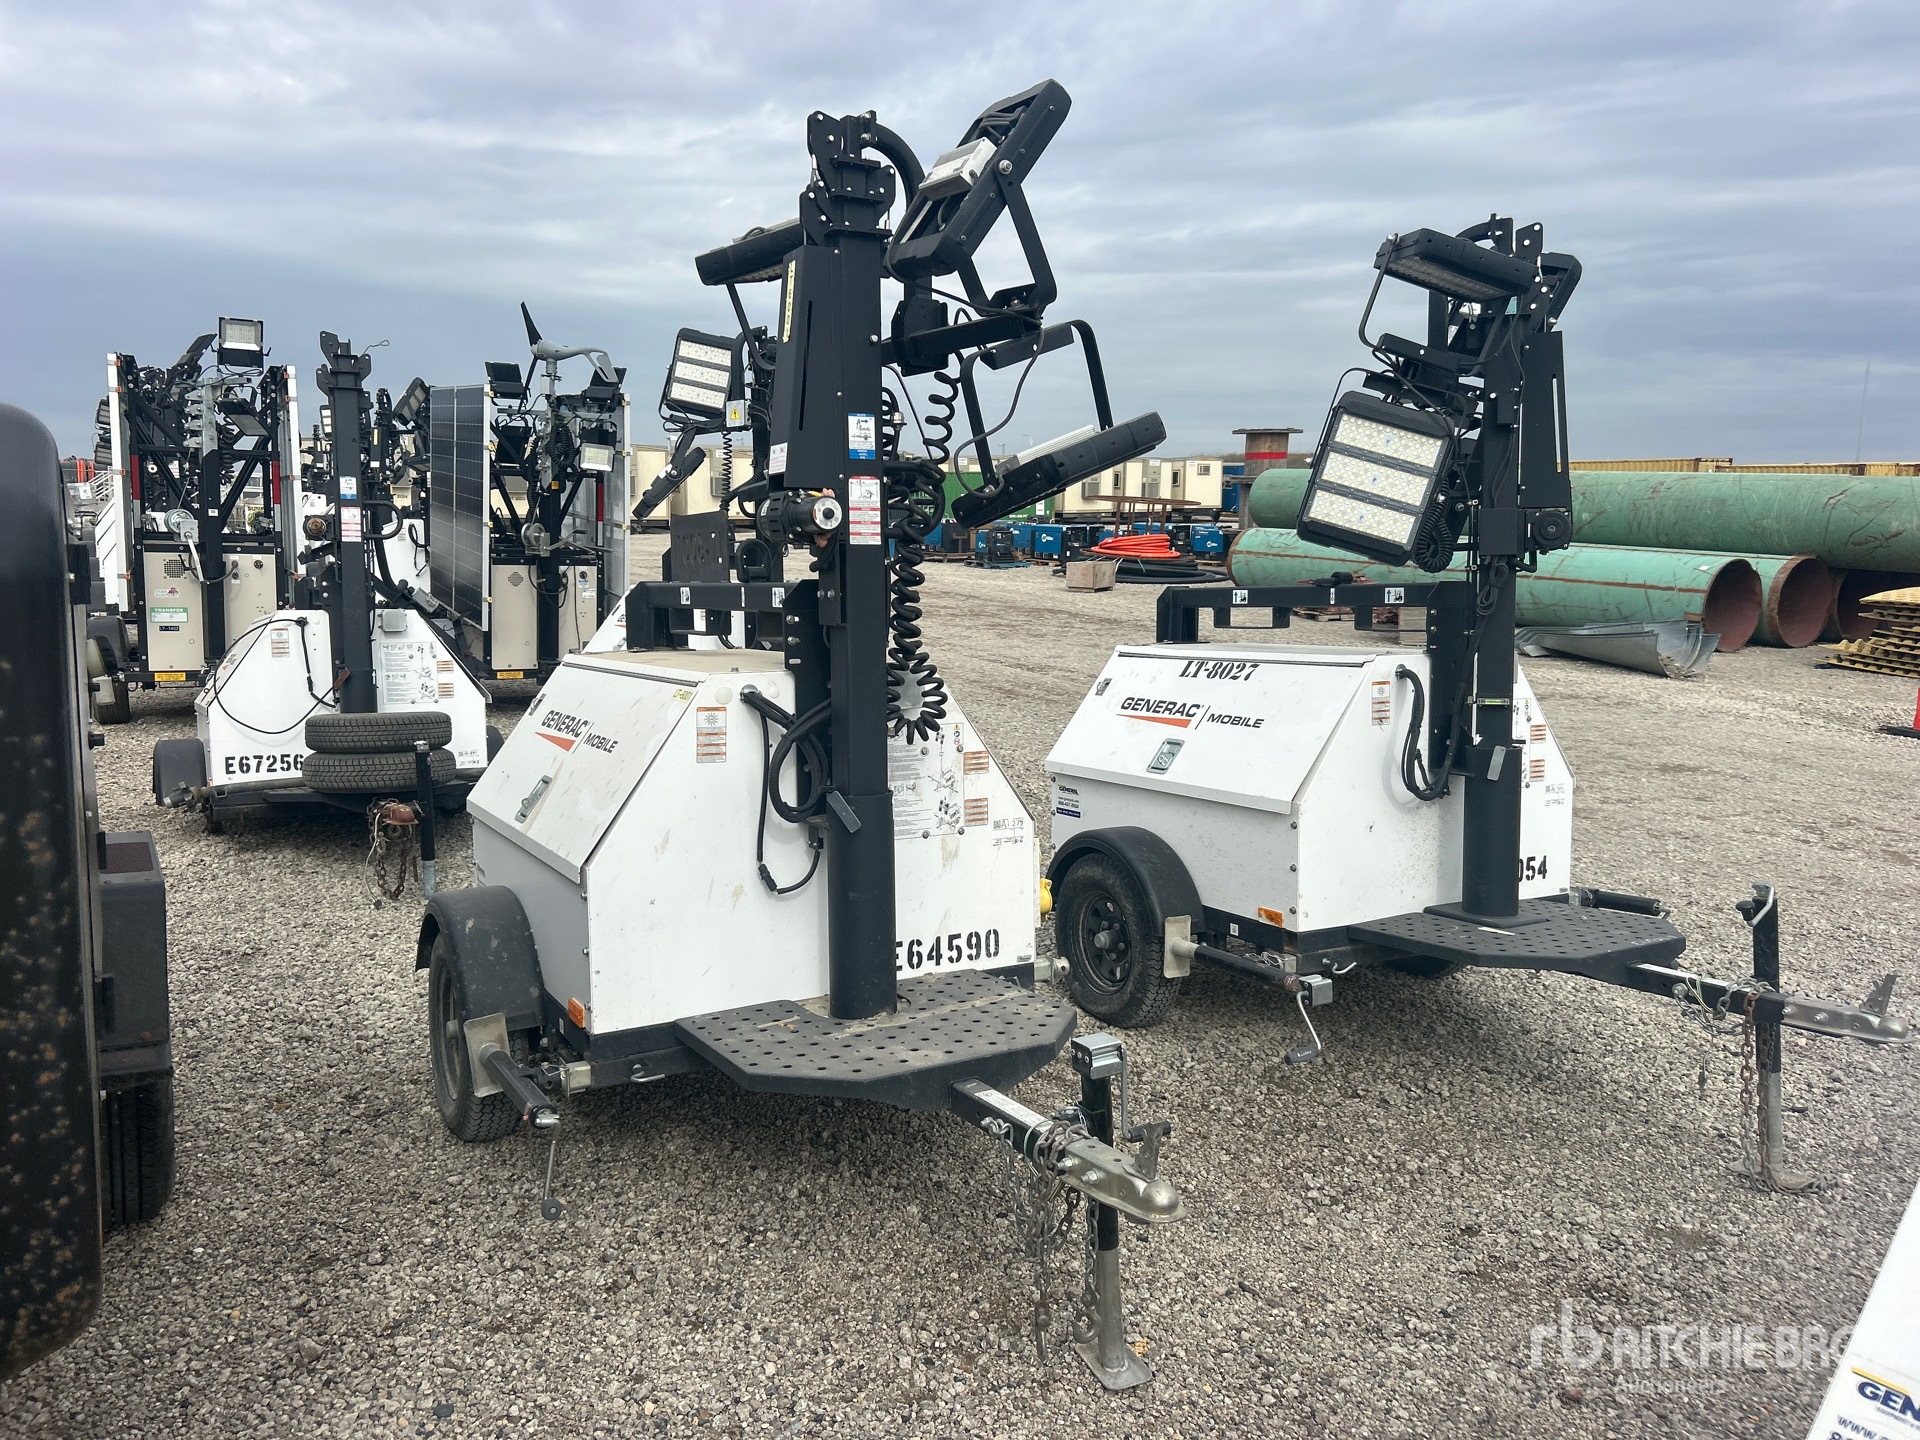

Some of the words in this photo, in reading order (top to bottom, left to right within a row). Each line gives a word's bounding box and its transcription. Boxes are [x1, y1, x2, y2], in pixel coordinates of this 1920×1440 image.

[1178, 660, 1260, 681] LT-8027
[1120, 697, 1200, 718] GENERAC
[1207, 713, 1265, 729] MOBILE
[541, 710, 589, 738] GENERAC
[583, 733, 619, 754] MOBILE
[224, 753, 304, 775] E67256
